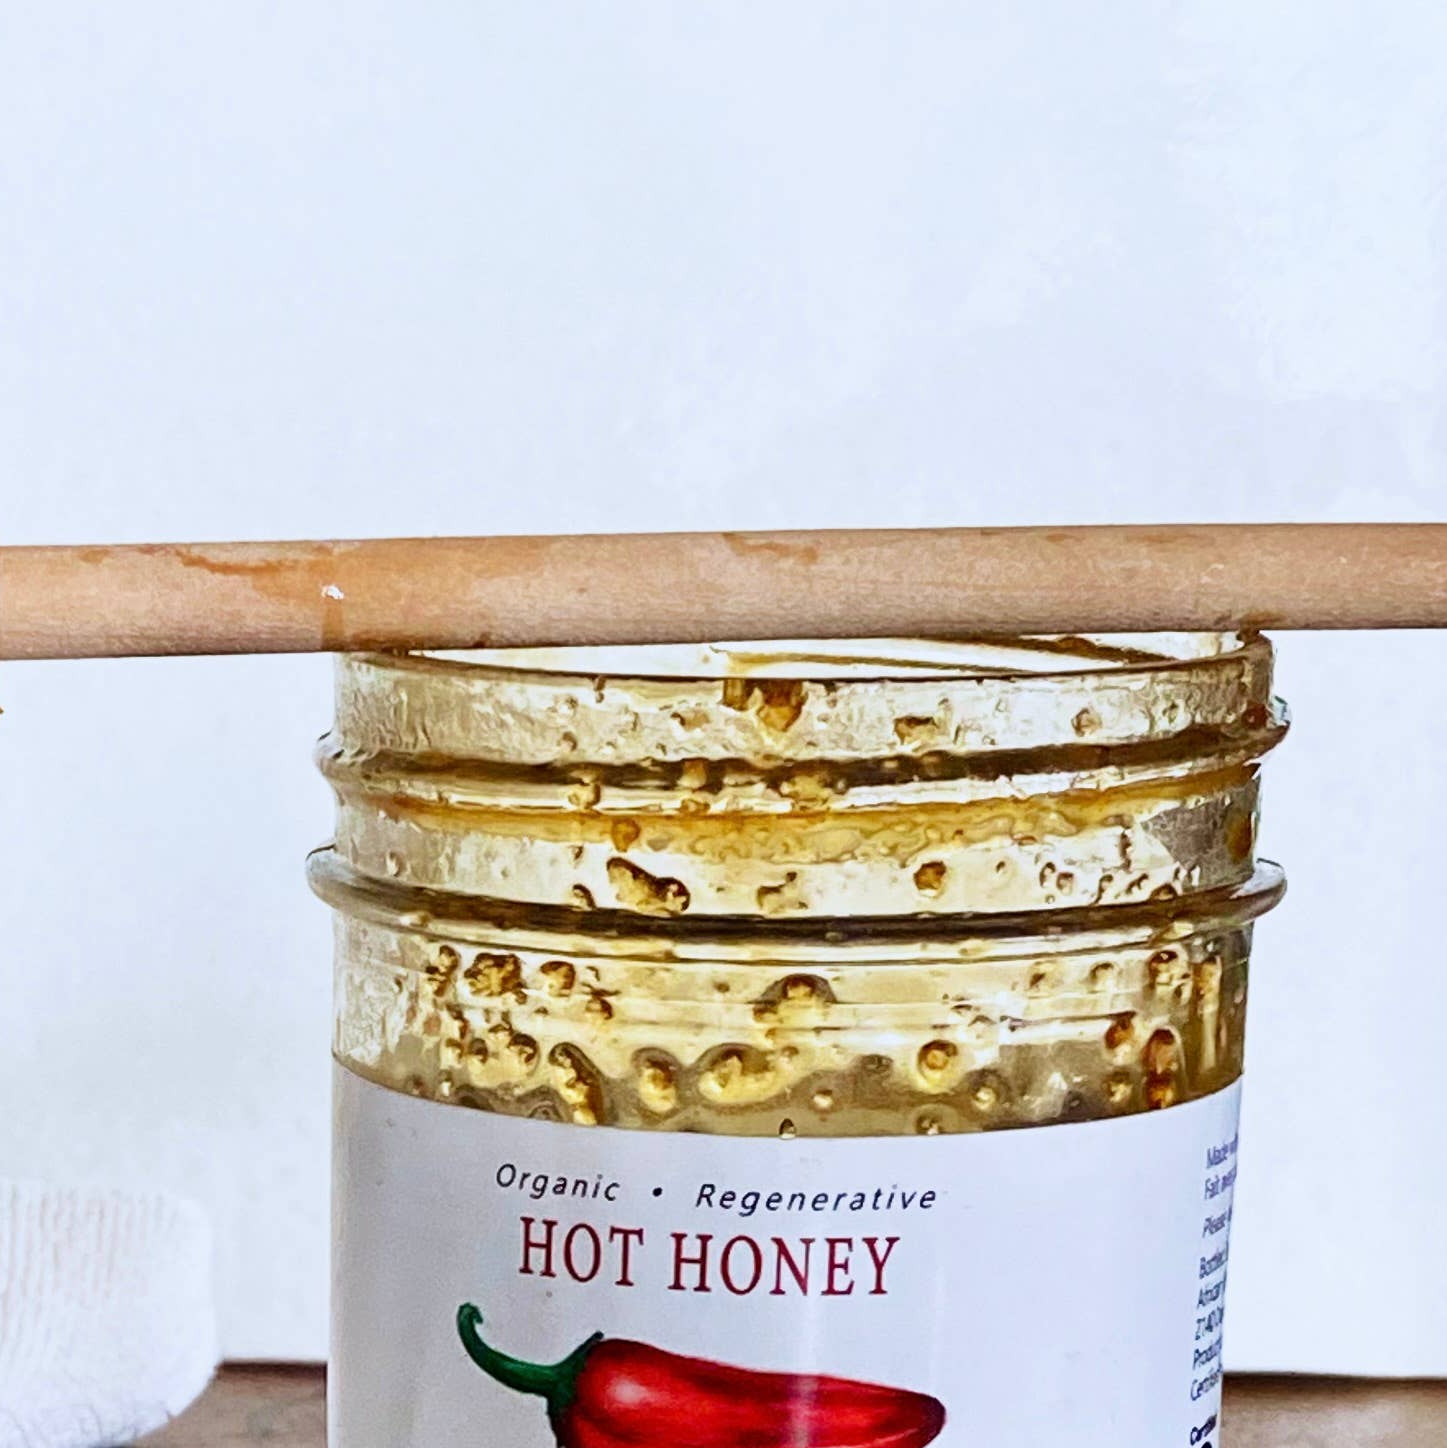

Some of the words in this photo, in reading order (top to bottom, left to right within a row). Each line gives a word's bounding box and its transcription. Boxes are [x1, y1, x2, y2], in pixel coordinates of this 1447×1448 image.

[496, 1163, 622, 1202] Organic
[695, 1183, 938, 1217] Regenerative
[518, 1216, 645, 1287] HOT
[668, 1232, 900, 1296] HONEY
